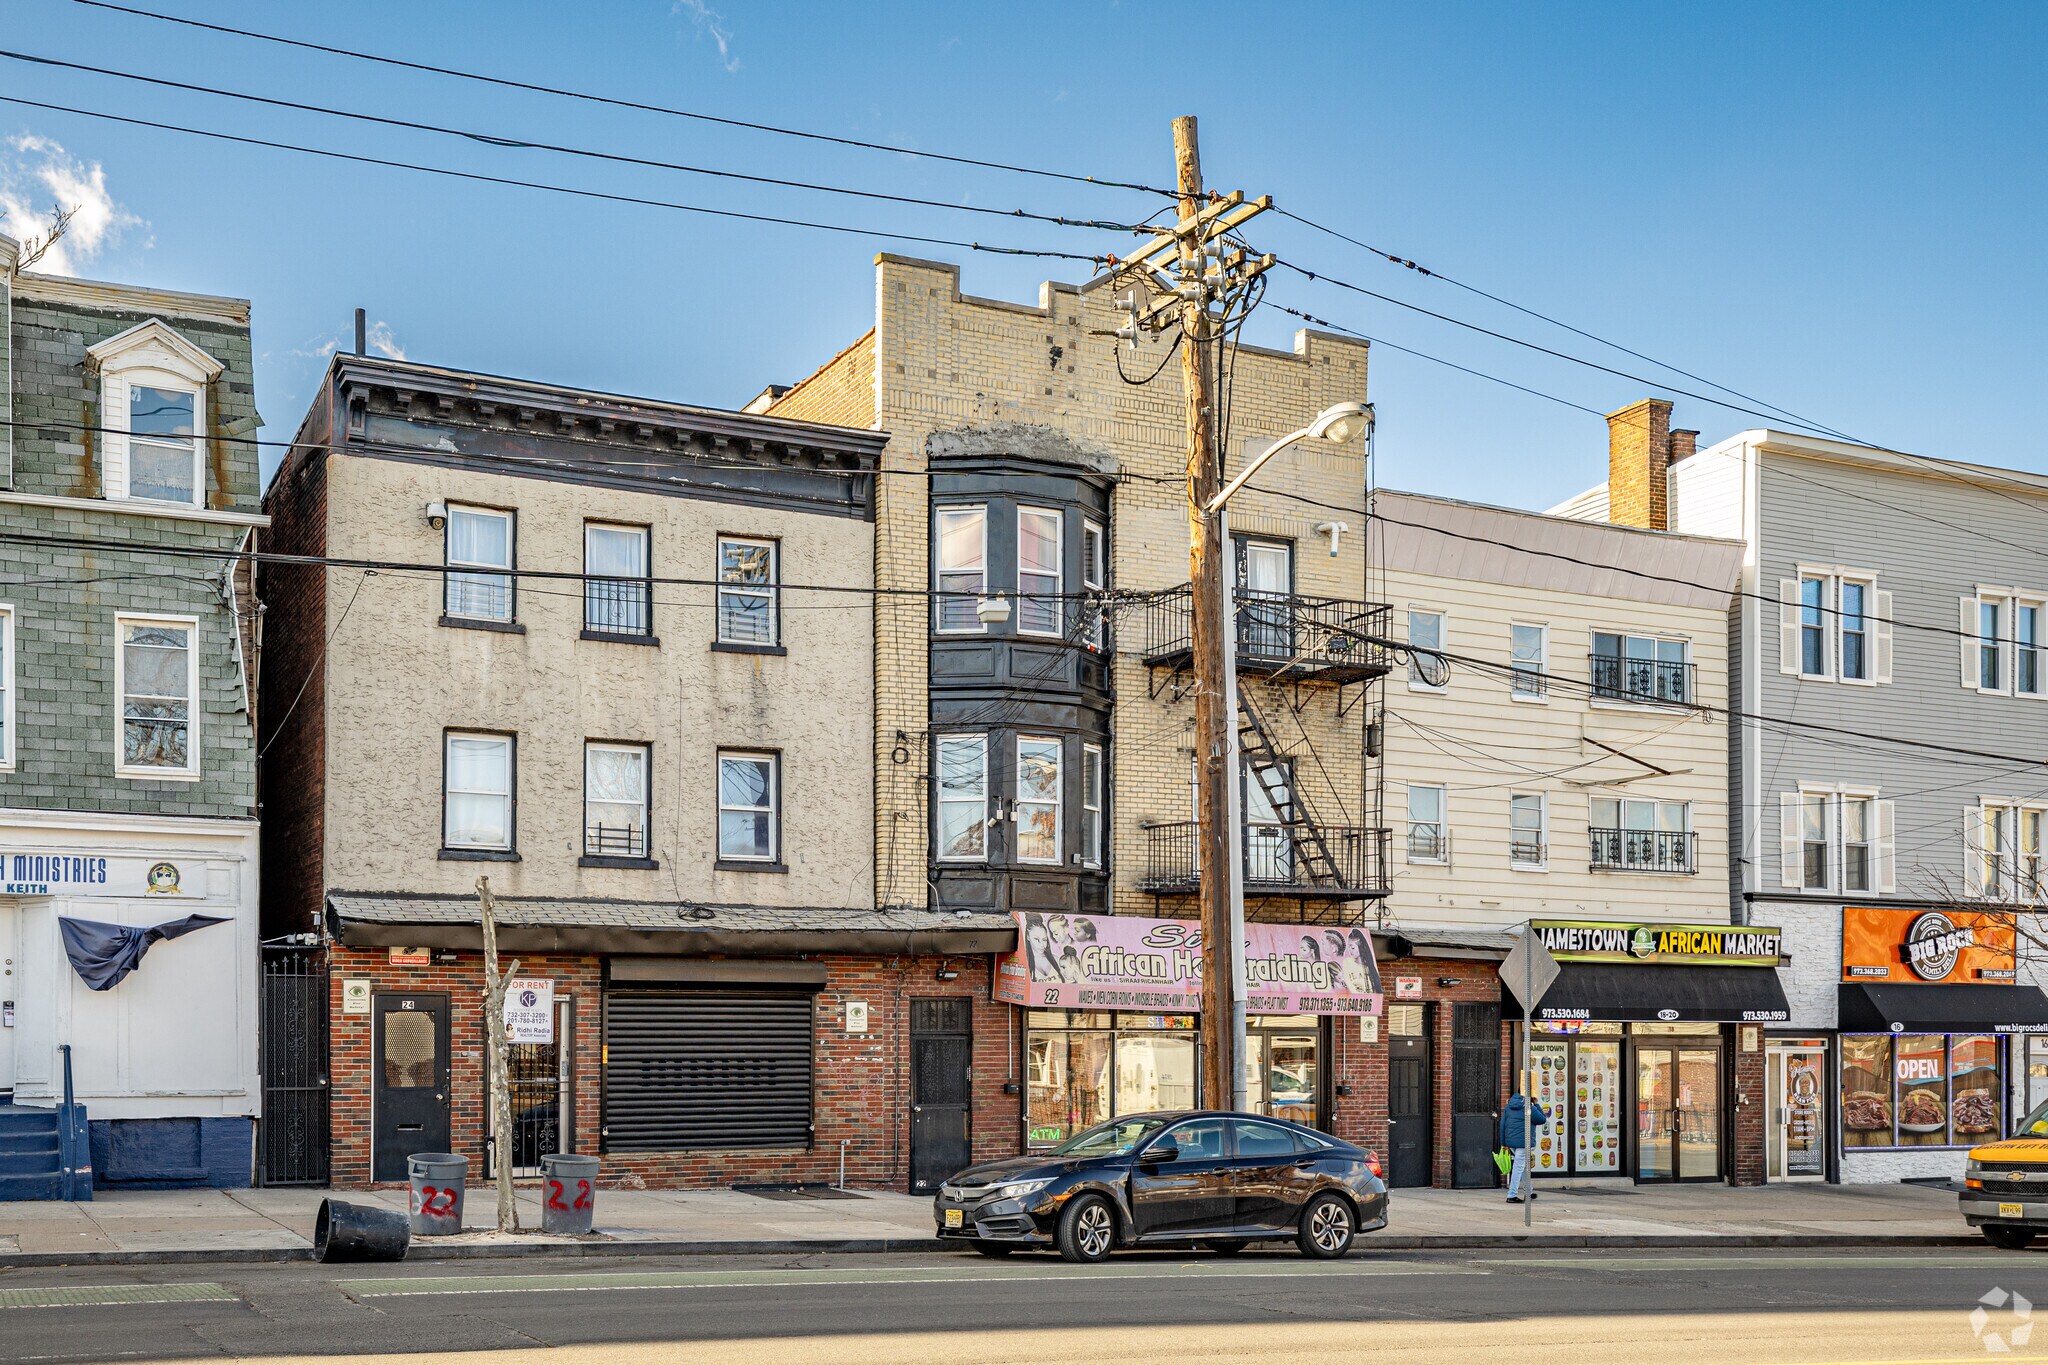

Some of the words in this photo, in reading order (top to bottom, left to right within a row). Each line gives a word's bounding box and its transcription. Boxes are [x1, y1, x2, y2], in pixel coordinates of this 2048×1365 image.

[14, 855, 106, 883] MINISTRIES
[7, 884, 47, 893] KEITH
[1541, 928, 1628, 951] JAMESTOWN
[1658, 931, 1721, 954] AFRICAN
[1724, 933, 1780, 955] MARKET
[1909, 939, 1935, 962] BIG
[1081, 946, 1167, 978] African
[1173, 949, 1203, 981] Ha
[1245, 953, 1328, 989] raiding
[1922, 964, 1942, 974] FAMILY
[510, 981, 524, 989] OR
[527, 981, 549, 989] RENT
[521, 993, 537, 1007] KP
[1044, 989, 1059, 1004] 22
[403, 1001, 413, 1009] 24
[1542, 1008, 1590, 1018] 973.530.1684
[1660, 1010, 1676, 1018] 18-20
[1742, 1011, 1787, 1020] 973.530.1959
[1898, 1059, 1938, 1079] OPEN
[1029, 1129, 1060, 1140] ATM
[421, 1186, 458, 1218] 22
